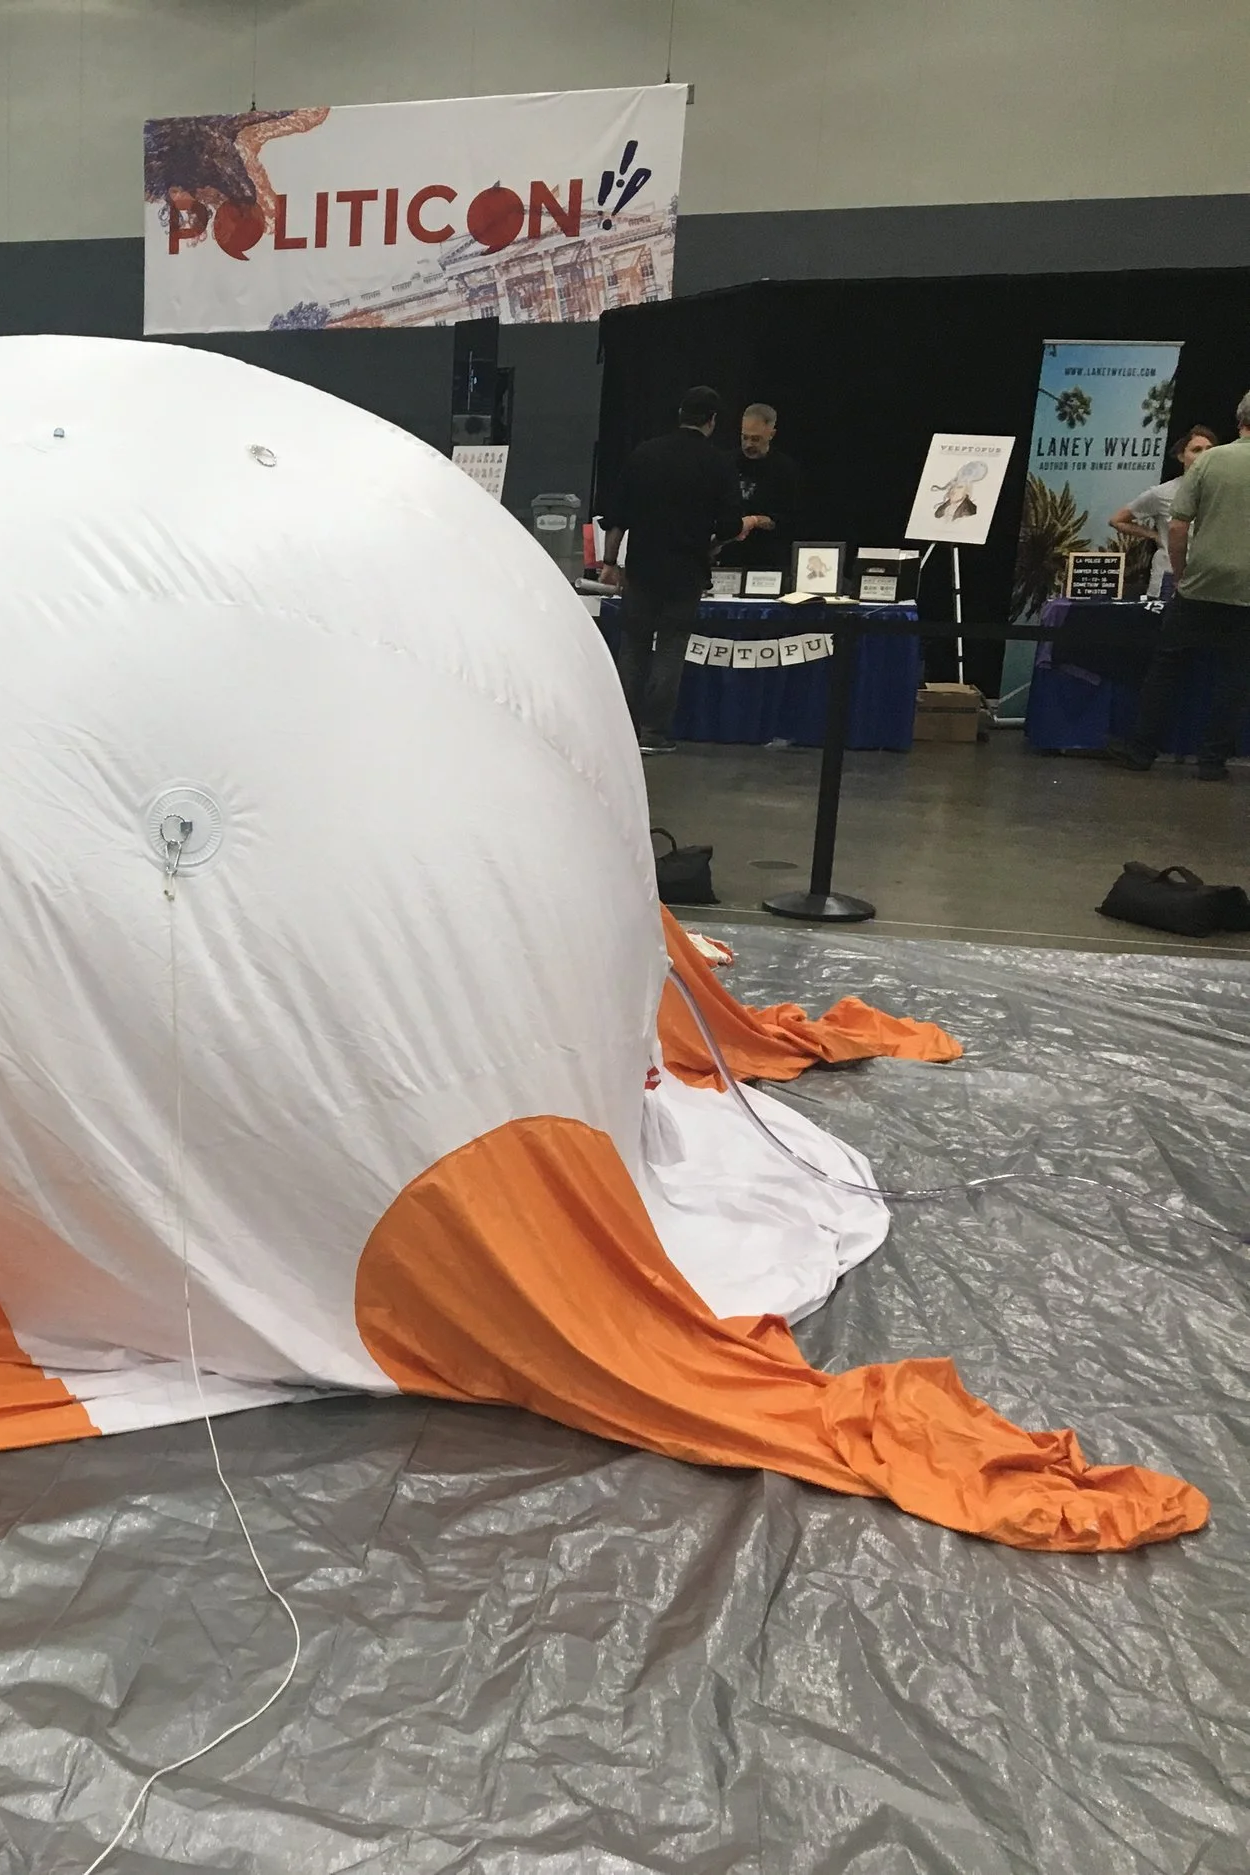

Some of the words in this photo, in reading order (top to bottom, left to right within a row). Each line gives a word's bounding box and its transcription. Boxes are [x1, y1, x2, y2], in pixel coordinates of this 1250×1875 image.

[167, 178, 584, 262] POLITICON
[940, 445, 1002, 453] VEEPTOPUS
[1036, 437, 1094, 457] LANEY
[1104, 437, 1163, 457] WYLDE
[1039, 462, 1069, 471] AUTHOR
[1072, 462, 1087, 471] FOR
[1116, 462, 1156, 471] WATCHERS
